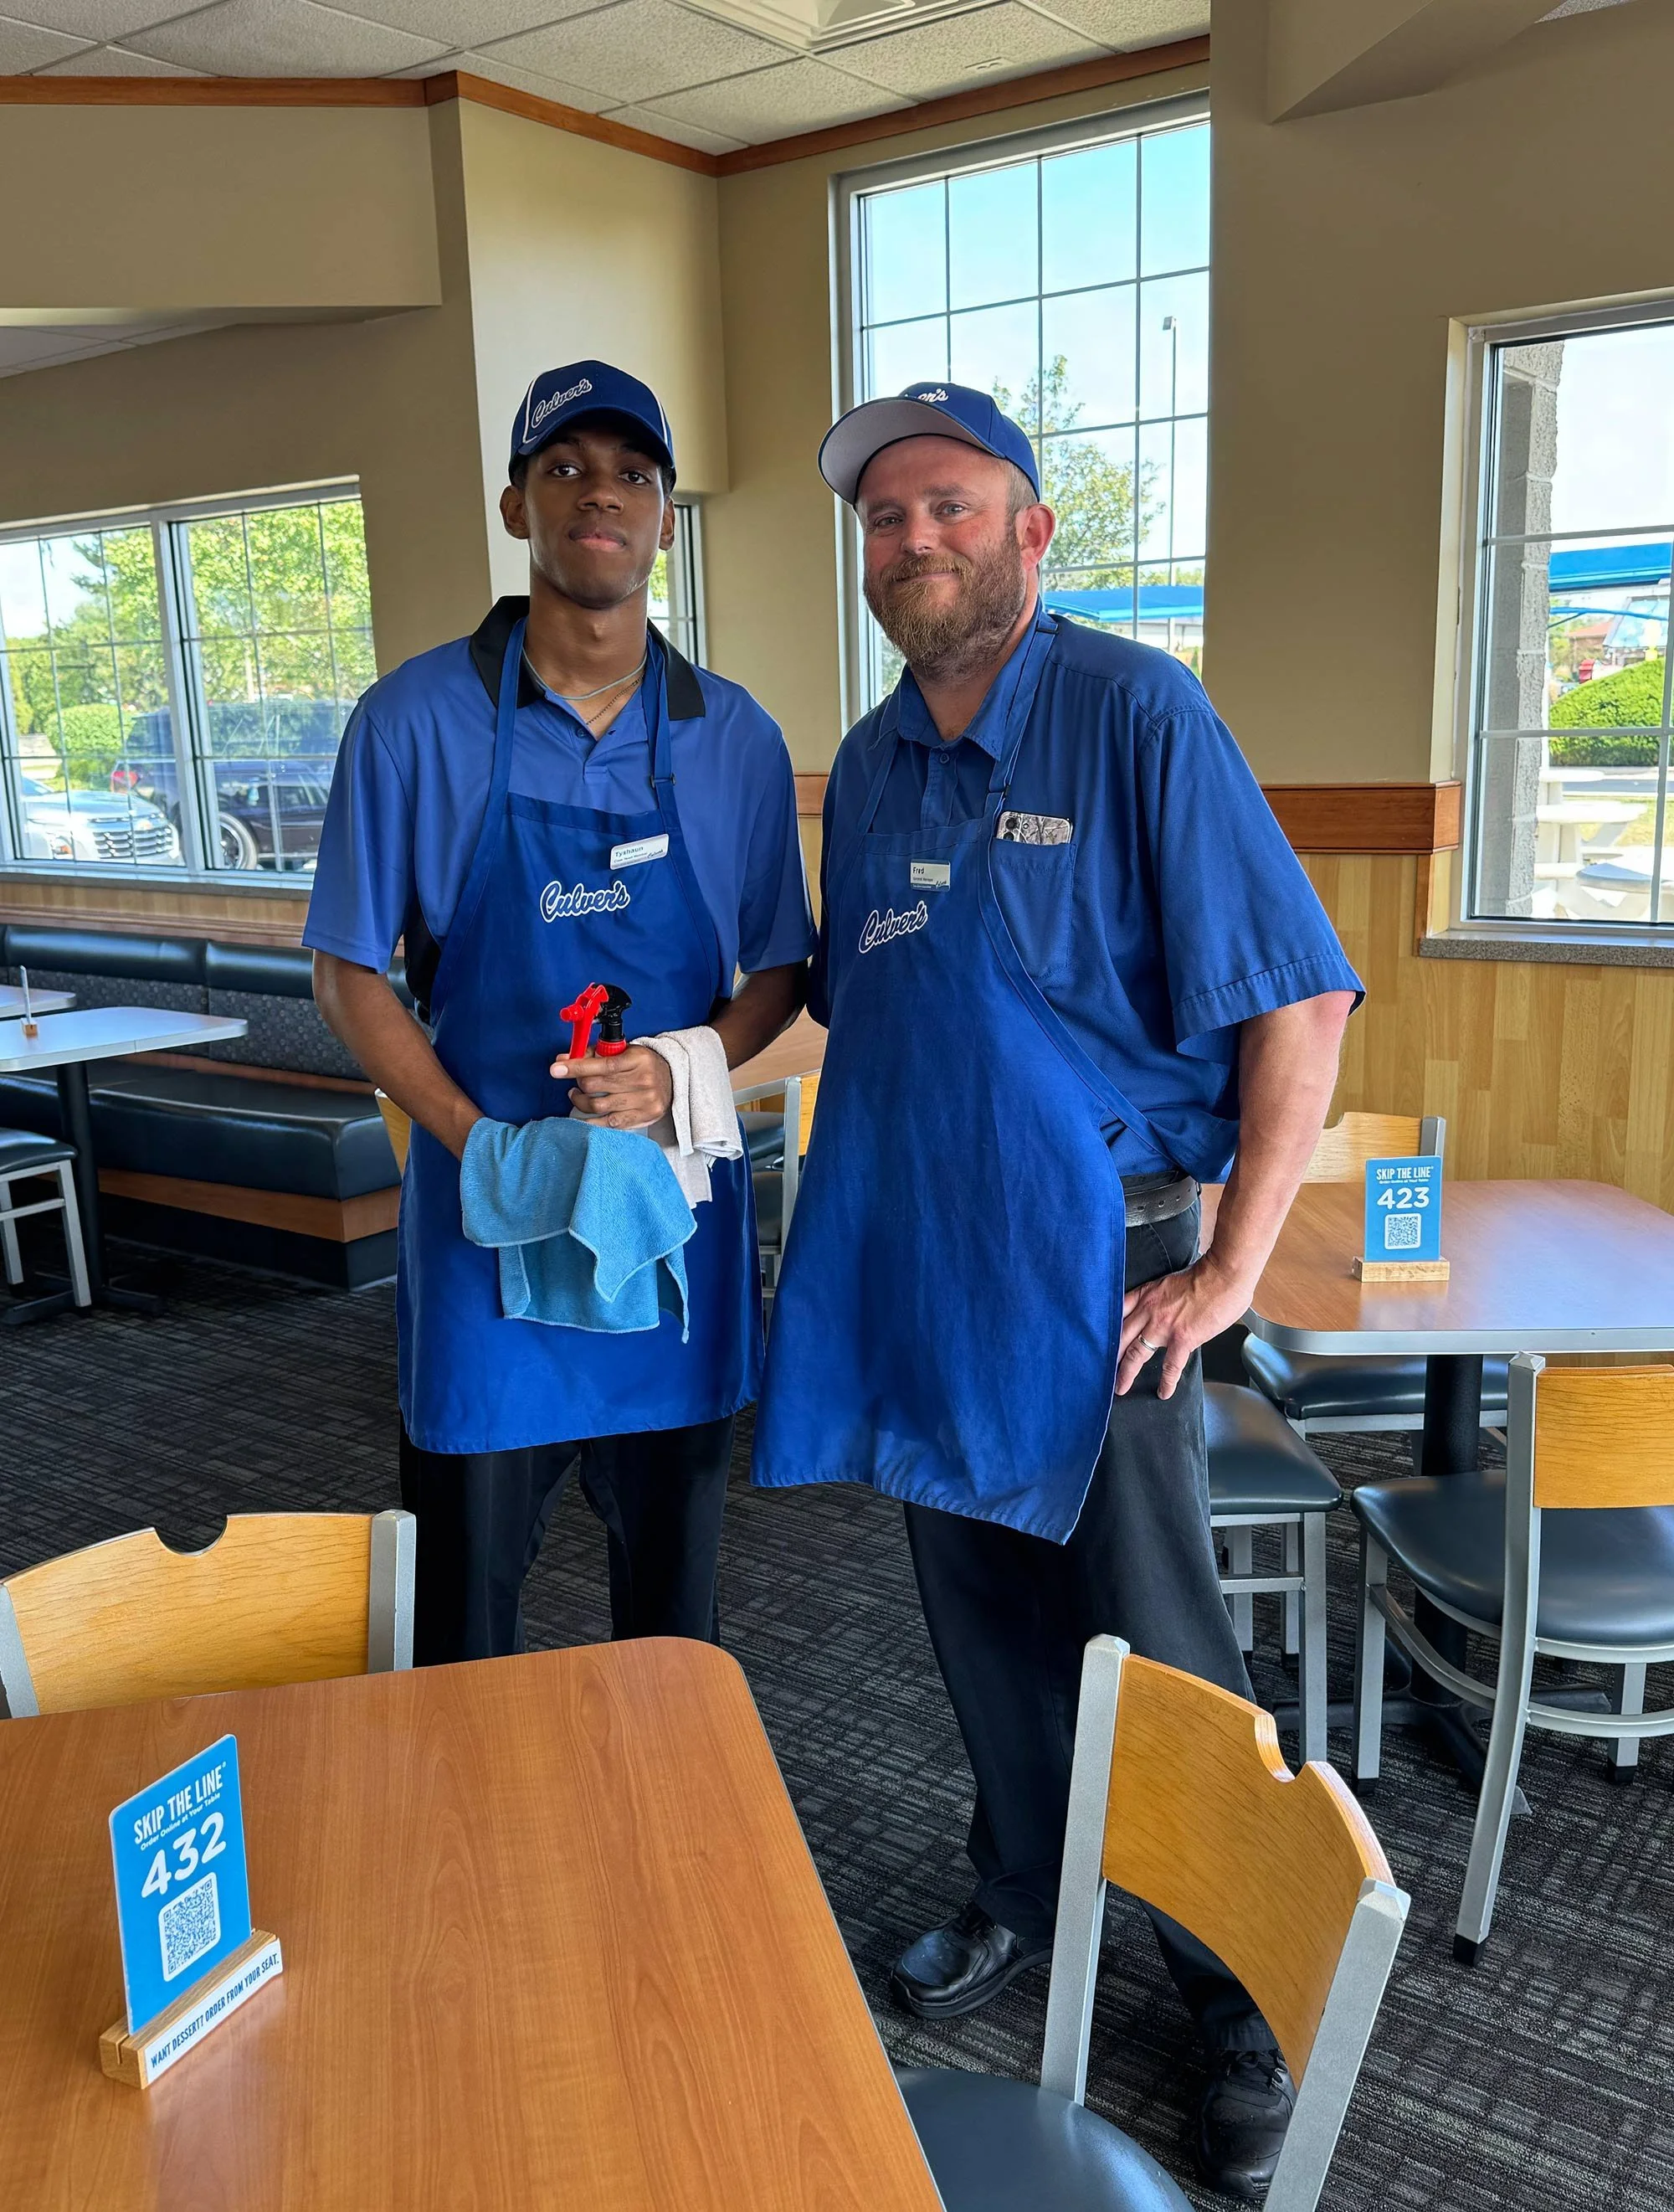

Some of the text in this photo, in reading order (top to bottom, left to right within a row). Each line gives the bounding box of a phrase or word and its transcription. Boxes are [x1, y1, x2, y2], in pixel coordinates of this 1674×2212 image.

[531, 378, 593, 429] Culver's
[540, 880, 631, 923] Culver's
[858, 900, 928, 954] Culver's
[1376, 1168, 1395, 1181] SKIP
[1396, 1167, 1412, 1180] THE
[1376, 1186, 1430, 1211] 423
[133, 1805, 165, 1845] SKIP
[167, 1785, 193, 1822] THE
[140, 1792, 221, 1851] Order Online at Your Table
[141, 1812, 227, 1899] 432
[151, 1952, 280, 2068] WANT DESSERT? ORDER FROM YOUR SEAT.
